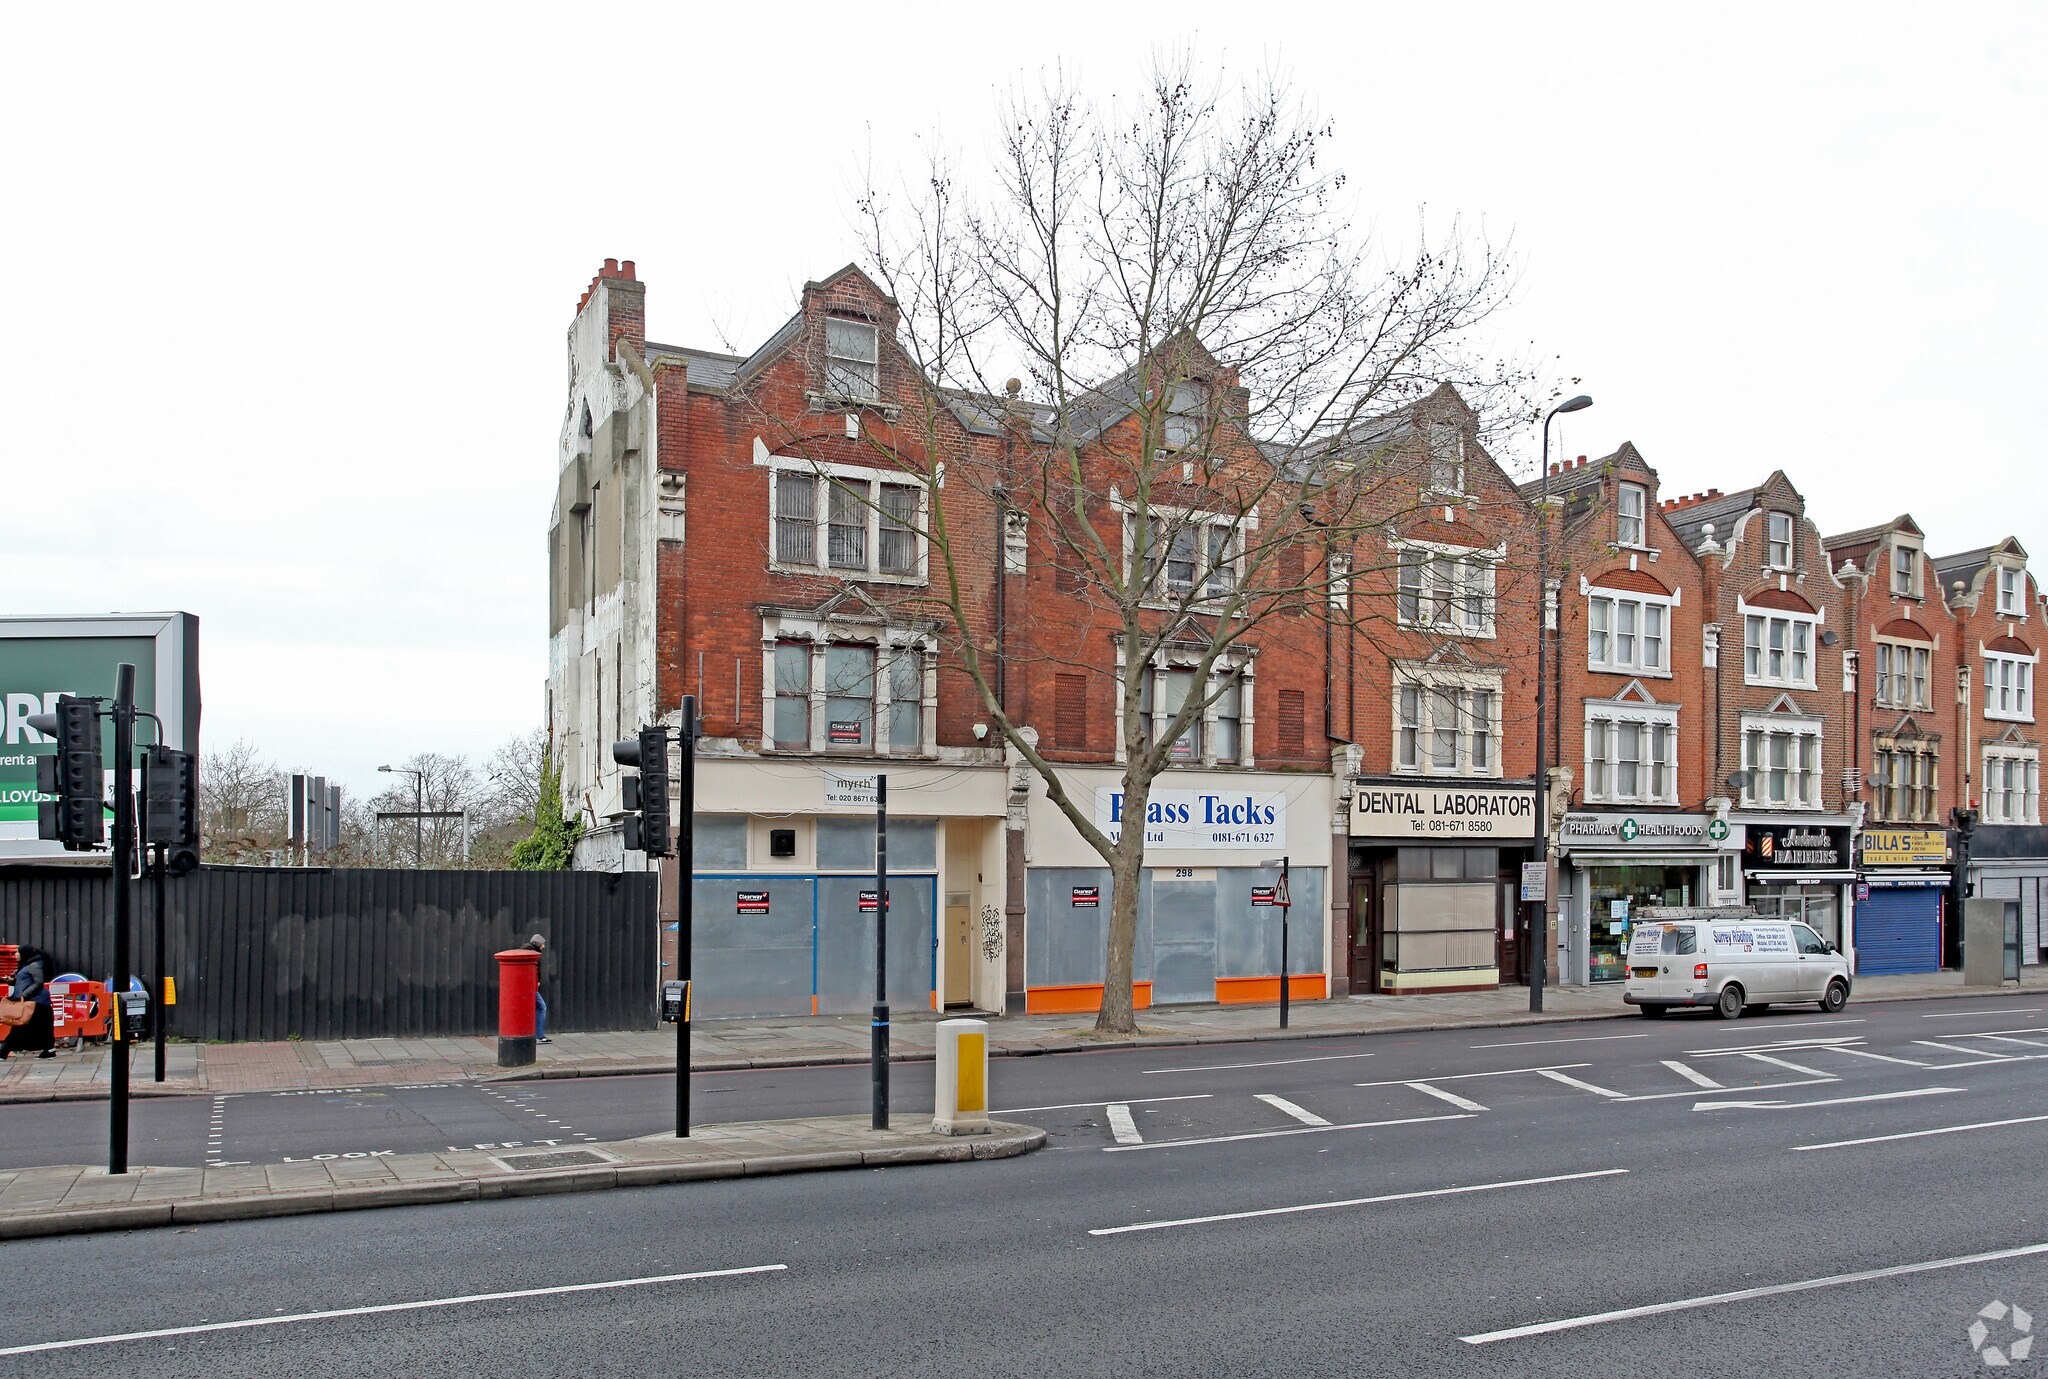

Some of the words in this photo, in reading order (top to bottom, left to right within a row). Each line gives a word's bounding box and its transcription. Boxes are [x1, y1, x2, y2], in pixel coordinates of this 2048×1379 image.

[832, 723, 855, 731] Clearway
[837, 779, 871, 790] myrrh
[0, 790, 51, 803] LOYDS
[839, 794, 852, 802] 020
[1109, 793, 1190, 824] Bass
[1199, 795, 1275, 825] Tacks
[1359, 792, 1424, 814] DENTAL
[1411, 820, 1425, 831] Tel:
[1429, 821, 1465, 831] 081-671
[1468, 821, 1492, 832] 8580
[1569, 823, 1620, 835] PHARMACY
[1639, 824, 1672, 835] HEALTH
[1674, 825, 1703, 836] FOODS
[1147, 832, 1164, 842] Ltd
[1212, 832, 1250, 843] 0181-671
[1253, 833, 1275, 843] 6327
[1865, 834, 1911, 851] BILLA'S
[1774, 850, 1838, 864] BARBERS
[1175, 869, 1193, 877] 298
[739, 893, 763, 901] Clearway
[1713, 930, 1731, 946] Surrey
[1731, 930, 1754, 946] Roofing
[283, 1150, 396, 1162] LOOK
[447, 1139, 562, 1152] LEFT
